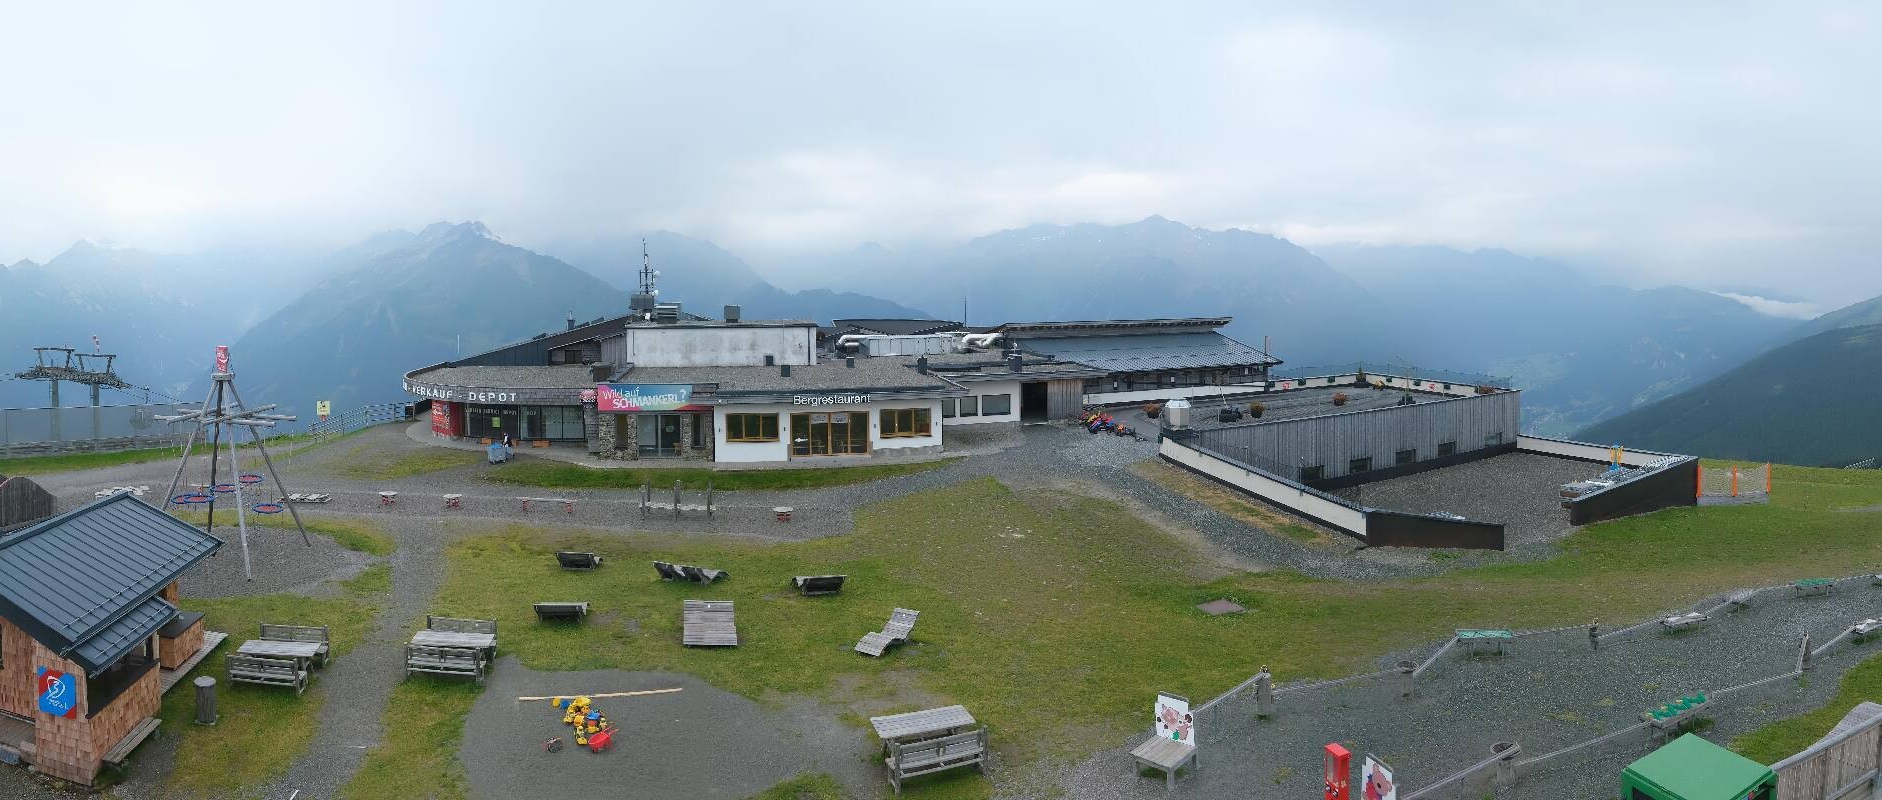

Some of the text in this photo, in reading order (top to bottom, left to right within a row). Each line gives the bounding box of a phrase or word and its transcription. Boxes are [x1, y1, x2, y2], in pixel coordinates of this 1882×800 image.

[412, 385, 453, 399] VERKAUF
[468, 391, 517, 402] DEPOT
[602, 386, 640, 400] Wild auf
[793, 393, 872, 407] Bergrestaurant
